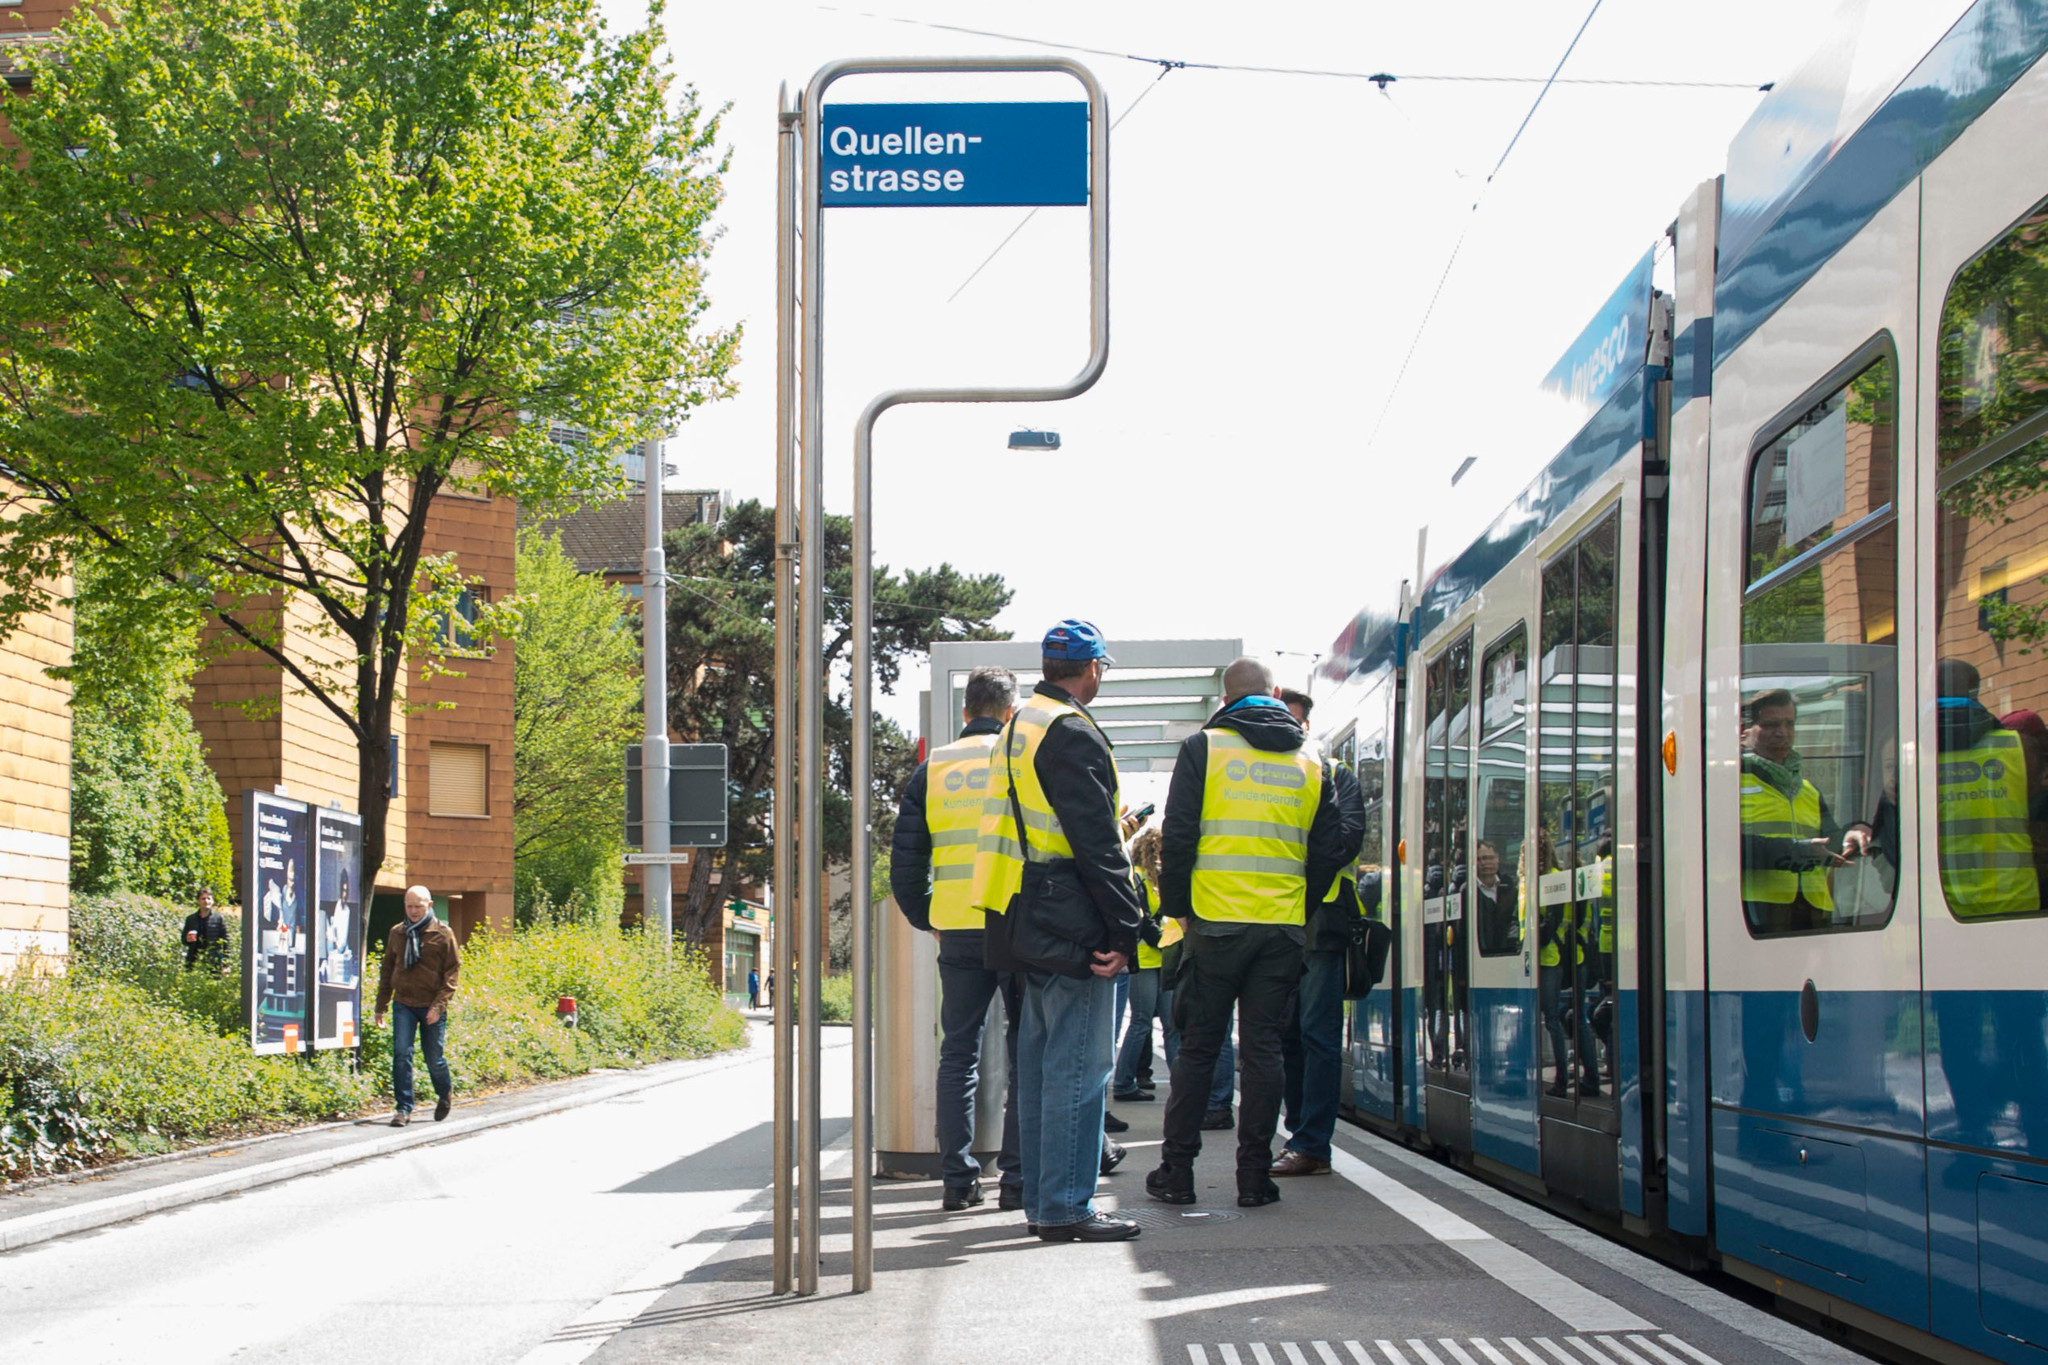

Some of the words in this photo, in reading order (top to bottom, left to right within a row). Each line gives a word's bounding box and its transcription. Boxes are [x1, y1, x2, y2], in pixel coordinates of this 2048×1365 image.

[830, 126, 982, 156] Quellen-
[830, 165, 965, 192] strasse
[943, 798, 984, 809] Kunden
[1223, 787, 1303, 809] Kundenberater
